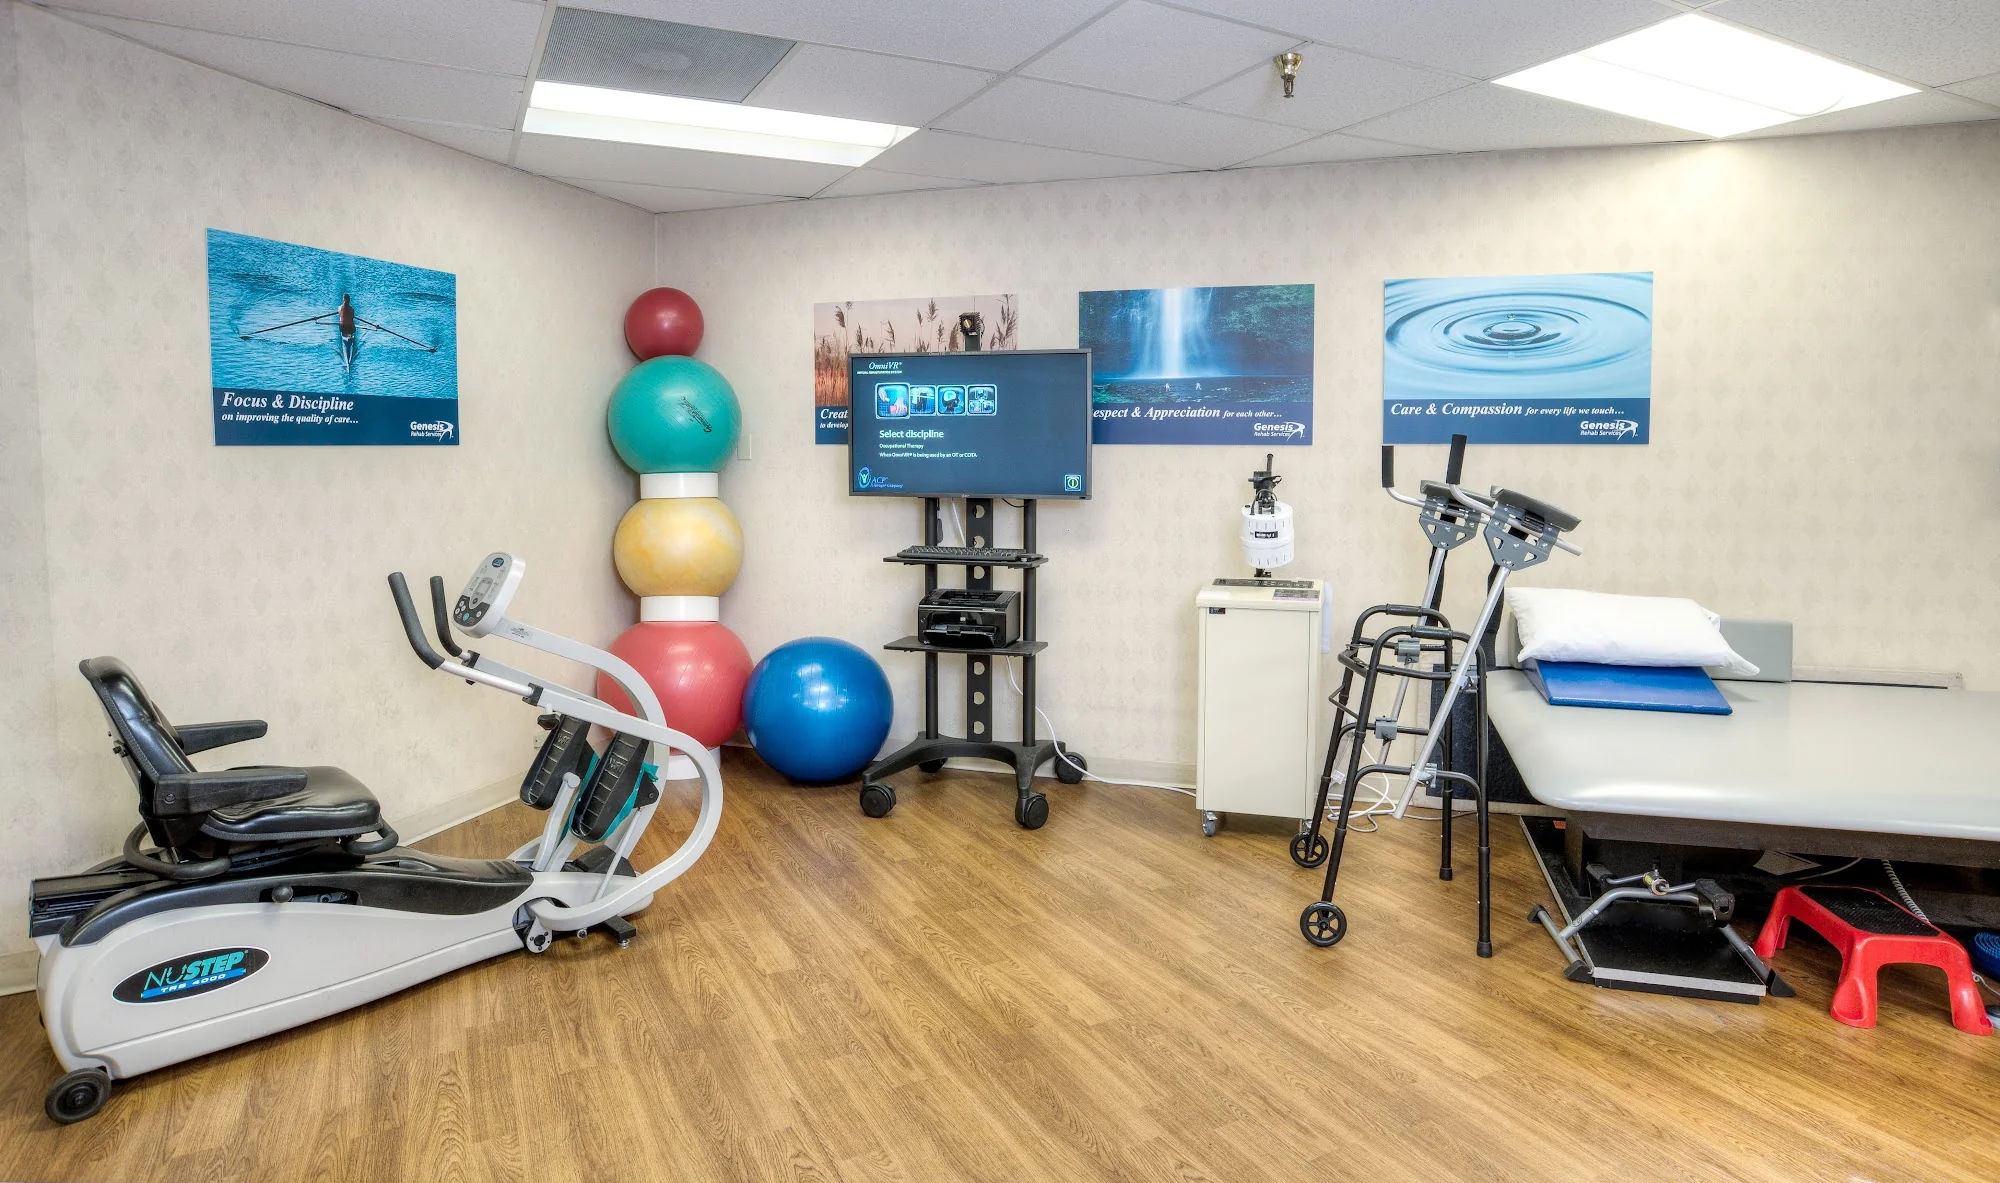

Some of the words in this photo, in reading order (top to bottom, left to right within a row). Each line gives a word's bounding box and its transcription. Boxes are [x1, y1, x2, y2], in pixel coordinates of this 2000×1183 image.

[222, 391, 268, 408] Focus
[272, 394, 284, 409] &
[288, 394, 354, 413] Discipline
[1093, 407, 1128, 419] espect
[1131, 407, 1141, 417] &
[1144, 406, 1220, 420] Appreciation
[1222, 410, 1235, 419] for
[1236, 410, 1252, 418] each
[1254, 410, 1282, 418] other...
[1391, 403, 1422, 415] Care
[1426, 403, 1437, 415] &
[1442, 402, 1523, 418] Compassion
[1525, 407, 1538, 416] for
[1540, 408, 1562, 416] every
[1562, 406, 1577, 416] life
[1591, 406, 1624, 415] touch...
[221, 413, 234, 421] on
[236, 412, 280, 424] improving
[281, 413, 294, 423] the
[296, 413, 323, 425] quality
[325, 414, 334, 425] of
[334, 416, 359, 424] care...
[410, 420, 444, 432] Genesis
[1254, 422, 1293, 431] Genesis
[1580, 420, 1625, 430] Genesis
[879, 430, 904, 438] Select
[905, 430, 944, 440] discipline
[193, 973, 226, 985] 4000
